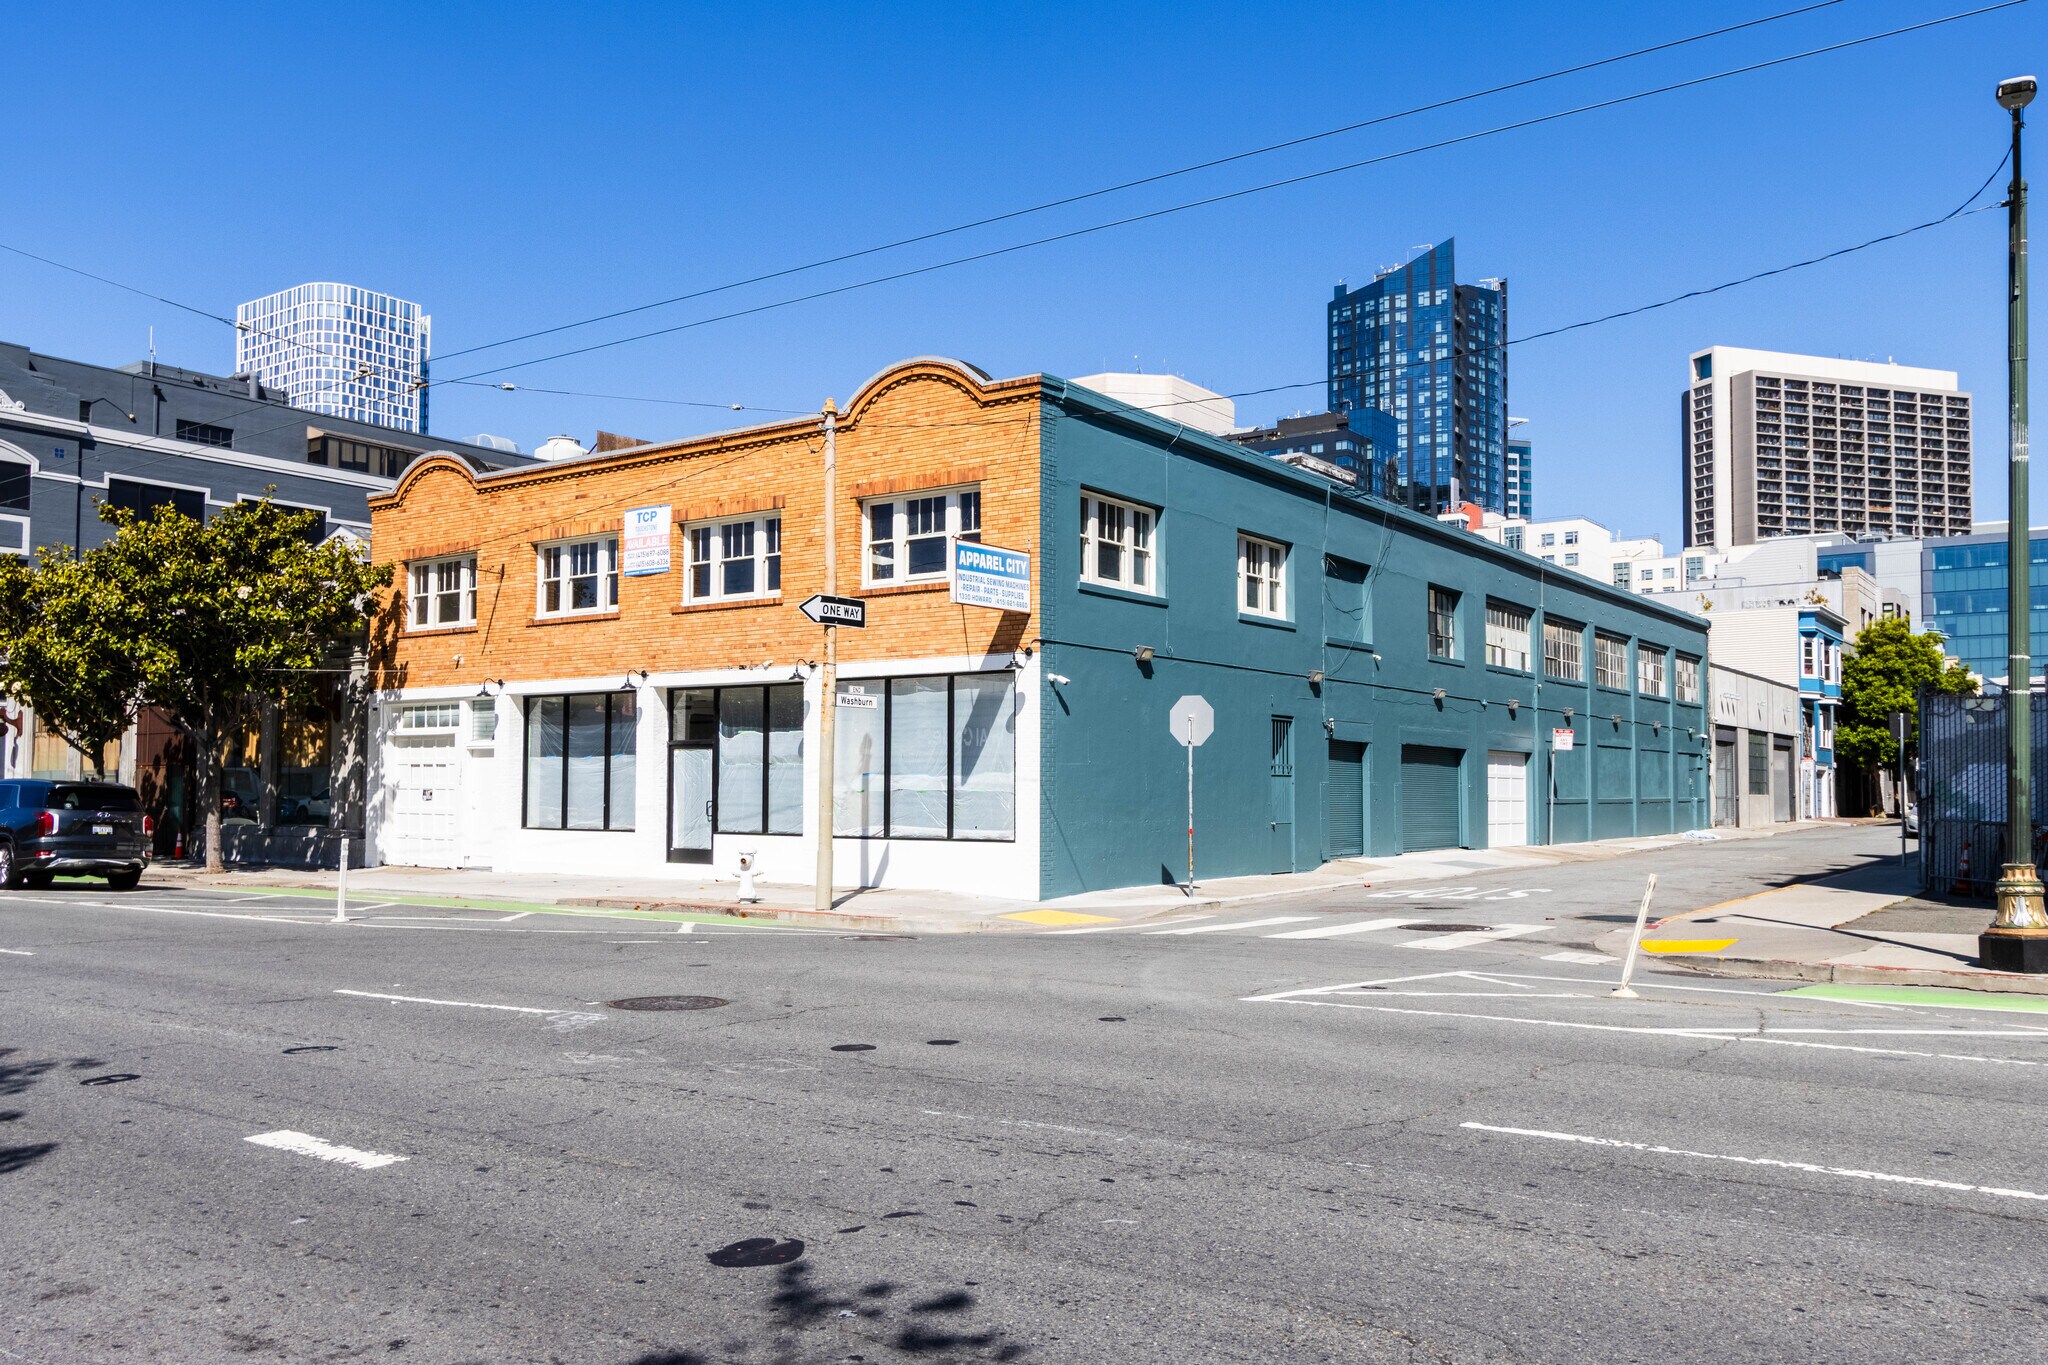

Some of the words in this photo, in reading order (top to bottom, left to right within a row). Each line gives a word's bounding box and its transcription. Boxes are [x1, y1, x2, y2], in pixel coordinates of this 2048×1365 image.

[637, 511, 657, 523] TCP
[626, 535, 669, 550] AVAILABLE
[959, 550, 1005, 572] APPAREL
[1006, 558, 1027, 575] CITY
[957, 573, 986, 584] INDUSTRIAL
[987, 577, 1005, 588] SEWING
[1005, 580, 1030, 591] MACHINES
[972, 594, 992, 604] HOWARD
[984, 587, 999, 596] PARTS
[1002, 589, 1025, 600] SUPPLIES
[822, 604, 841, 616] ONE
[843, 606, 860, 618] WAY
[841, 696, 872, 706] Washburn
